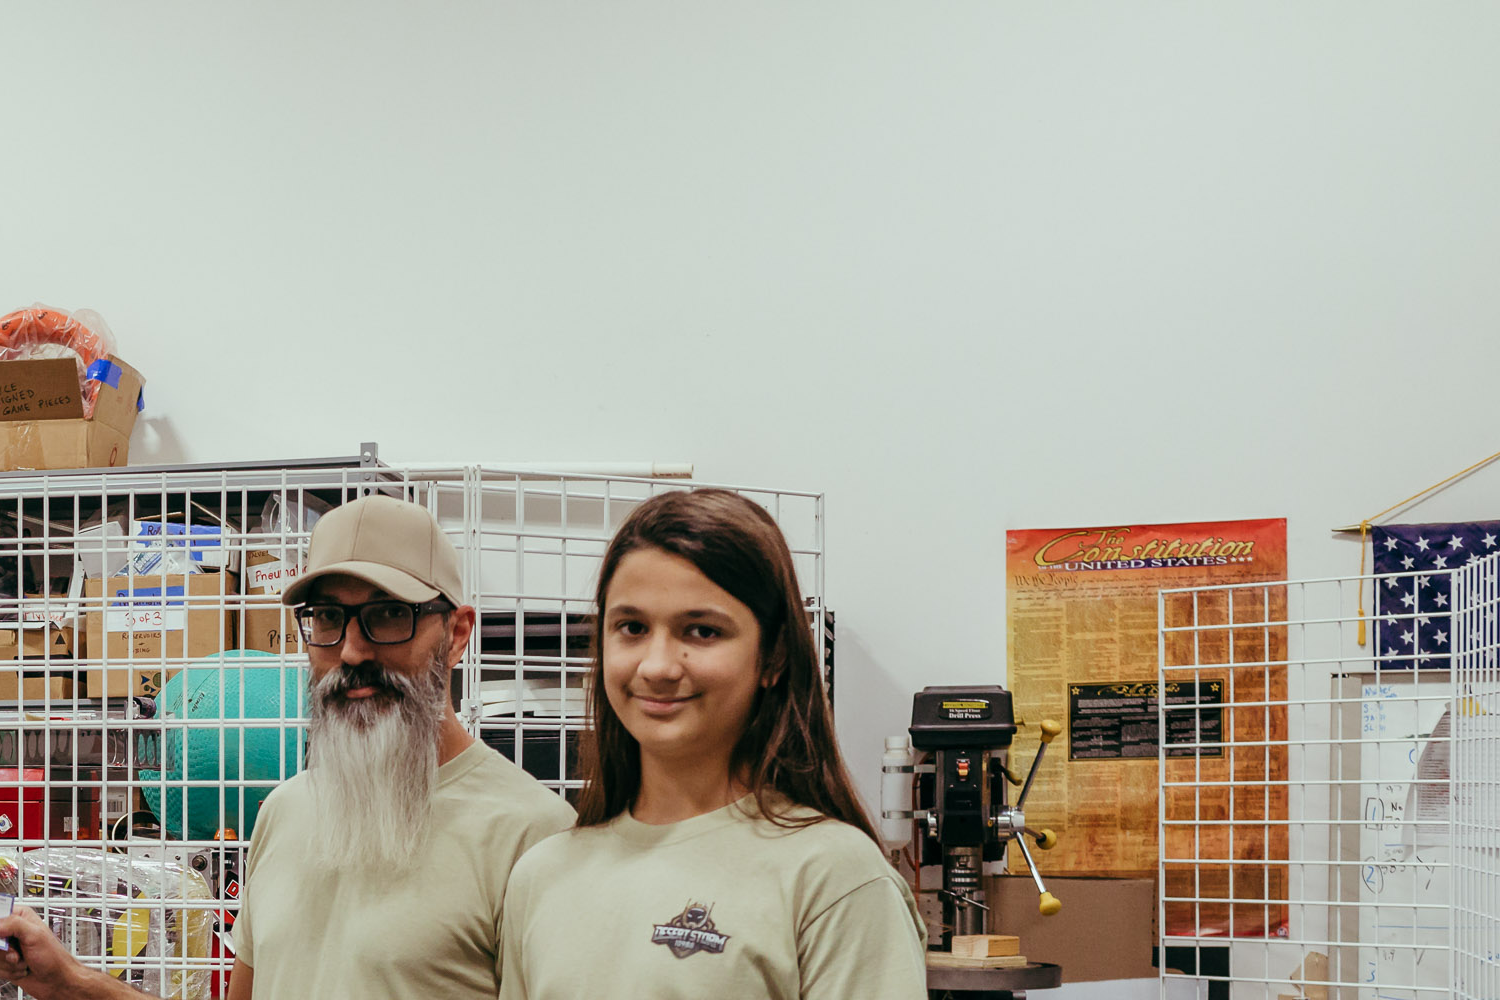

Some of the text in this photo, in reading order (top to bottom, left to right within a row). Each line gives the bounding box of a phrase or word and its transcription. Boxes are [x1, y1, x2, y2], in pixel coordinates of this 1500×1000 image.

[2, 394, 71, 416] GAME PIECES
[1033, 531, 1256, 567] Constitution
[1064, 558, 1146, 571] UNITED
[1149, 556, 1228, 569] STATES
[139, 612, 150, 623] of
[152, 611, 162, 626] 3
[121, 632, 162, 640] RSERVOIRS
